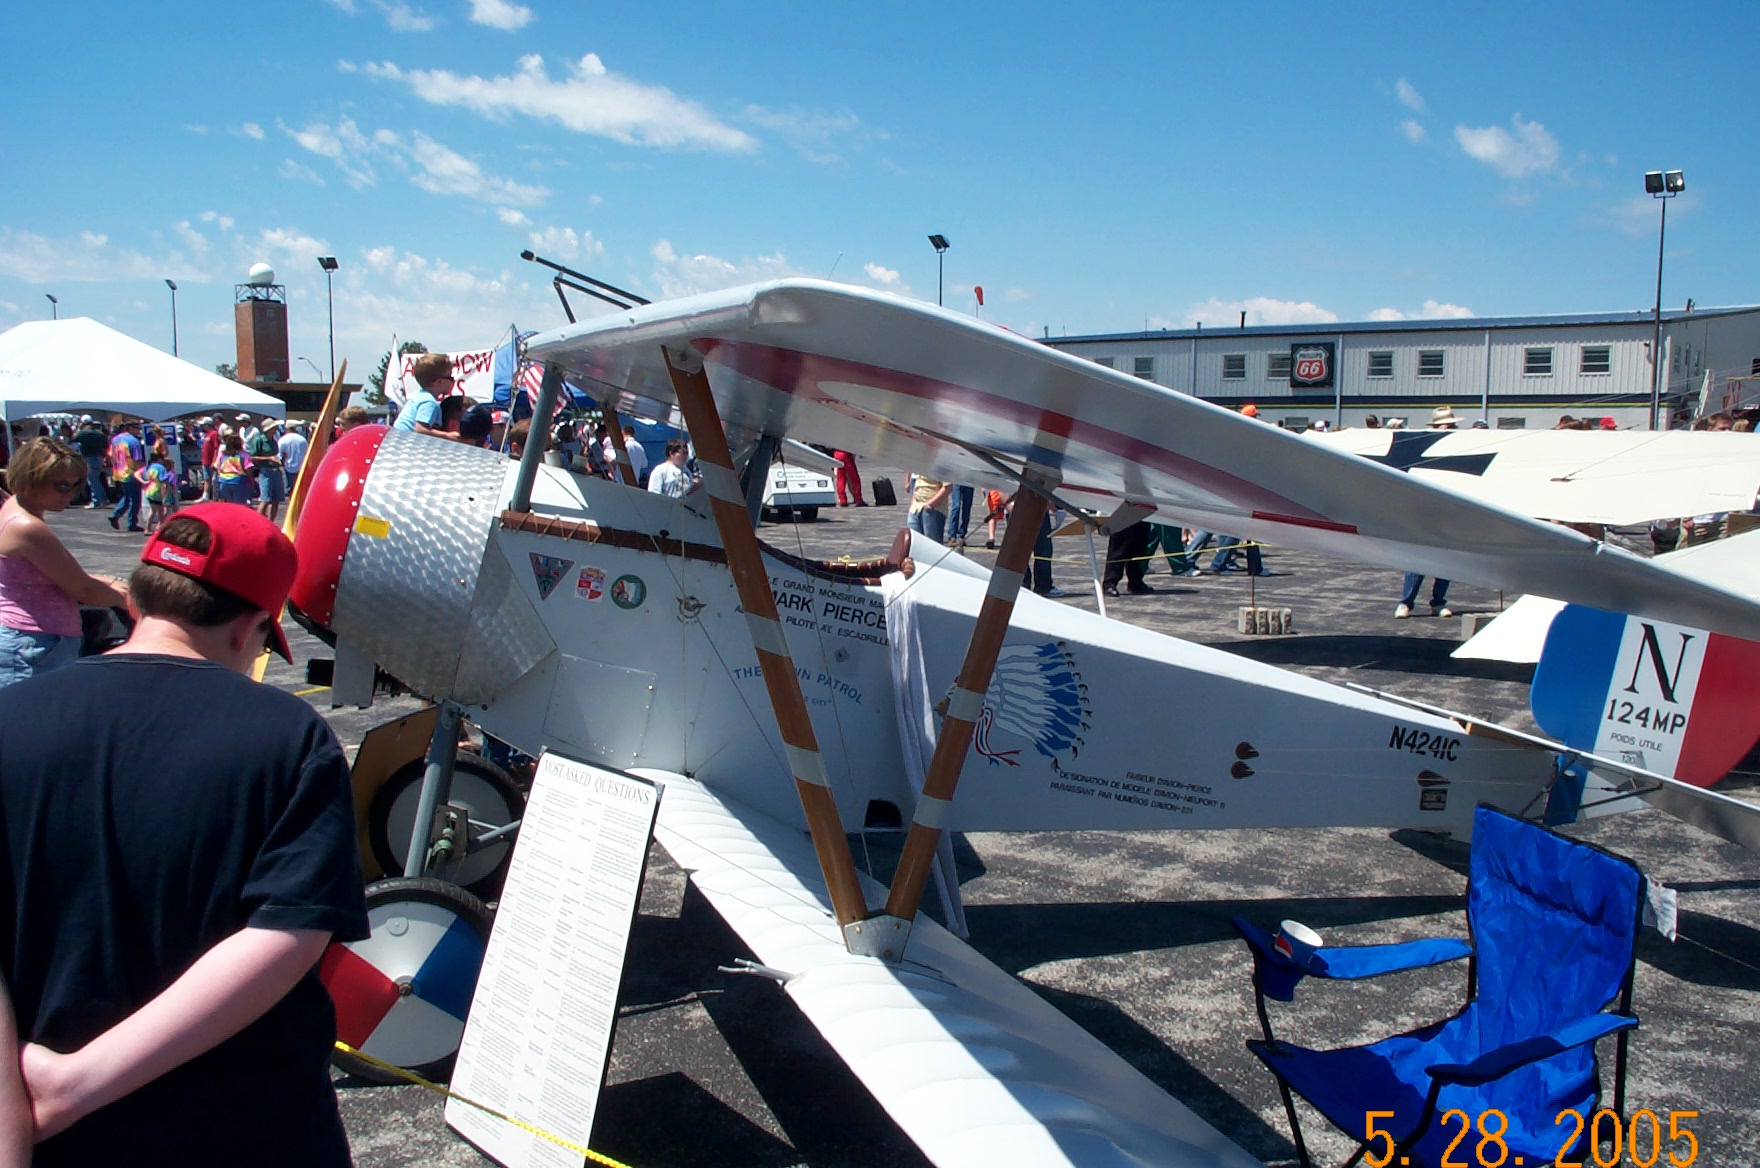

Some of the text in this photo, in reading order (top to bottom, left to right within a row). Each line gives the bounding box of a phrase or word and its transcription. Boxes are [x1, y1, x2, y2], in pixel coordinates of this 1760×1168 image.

[1300, 361, 1321, 376] 66
[783, 579, 815, 594] GRAND
[819, 588, 866, 605] MONSIEUR
[786, 616, 817, 630] PILOTE
[823, 602, 887, 631] PIERCE
[1622, 622, 1695, 704] N
[734, 666, 762, 680] THE
[817, 674, 863, 705] PATROL
[1607, 698, 1686, 735] 124MP
[1610, 732, 1663, 752] POIDS UTILE
[543, 759, 651, 805] MOST ASKED QUESTIONS
[1110, 780, 1121, 790] DE
